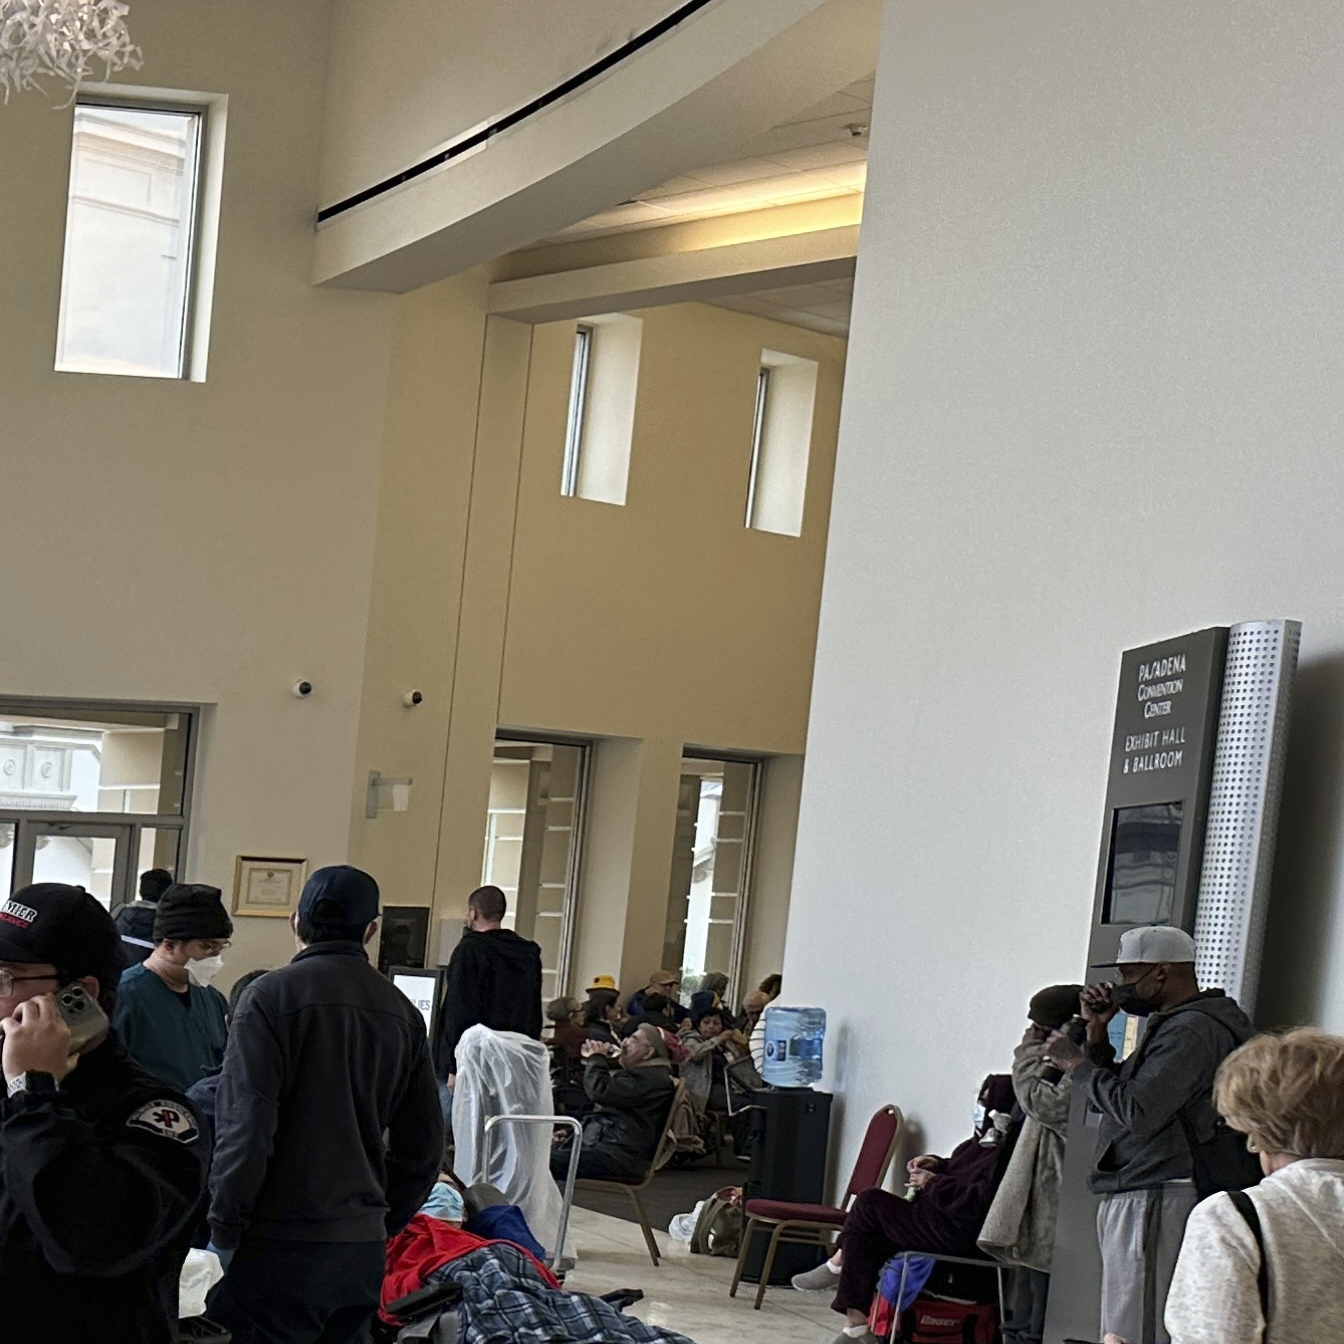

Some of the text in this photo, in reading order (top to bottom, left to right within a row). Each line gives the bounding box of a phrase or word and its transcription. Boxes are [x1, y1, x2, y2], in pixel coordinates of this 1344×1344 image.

[1138, 654, 1186, 682] PASADENA
[1144, 701, 1172, 718] CENTER
[1125, 727, 1185, 752] EXHIBIT HALL
[1123, 750, 1183, 774] & BALLROOM
